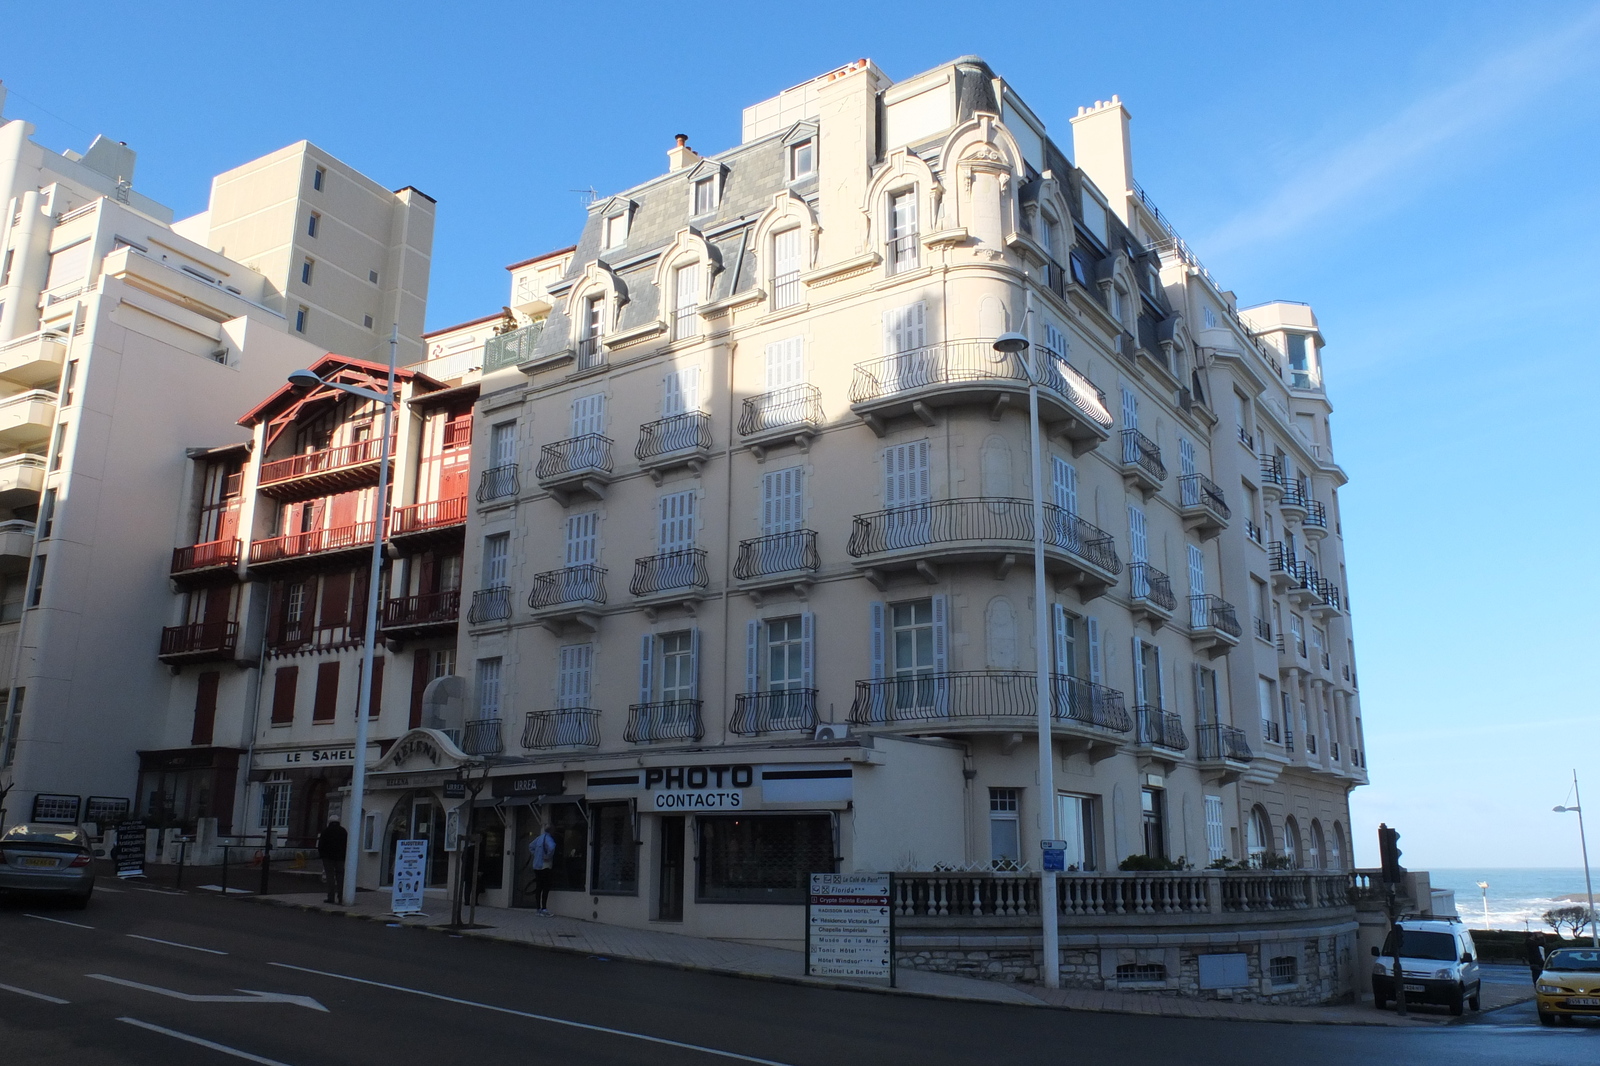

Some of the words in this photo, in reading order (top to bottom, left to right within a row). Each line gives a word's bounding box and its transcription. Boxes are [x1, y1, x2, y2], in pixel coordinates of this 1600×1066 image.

[286, 753, 301, 762] LE
[312, 750, 355, 761] SAHEL
[645, 765, 753, 790] PHOTO
[656, 793, 740, 807] CONTACT'S
